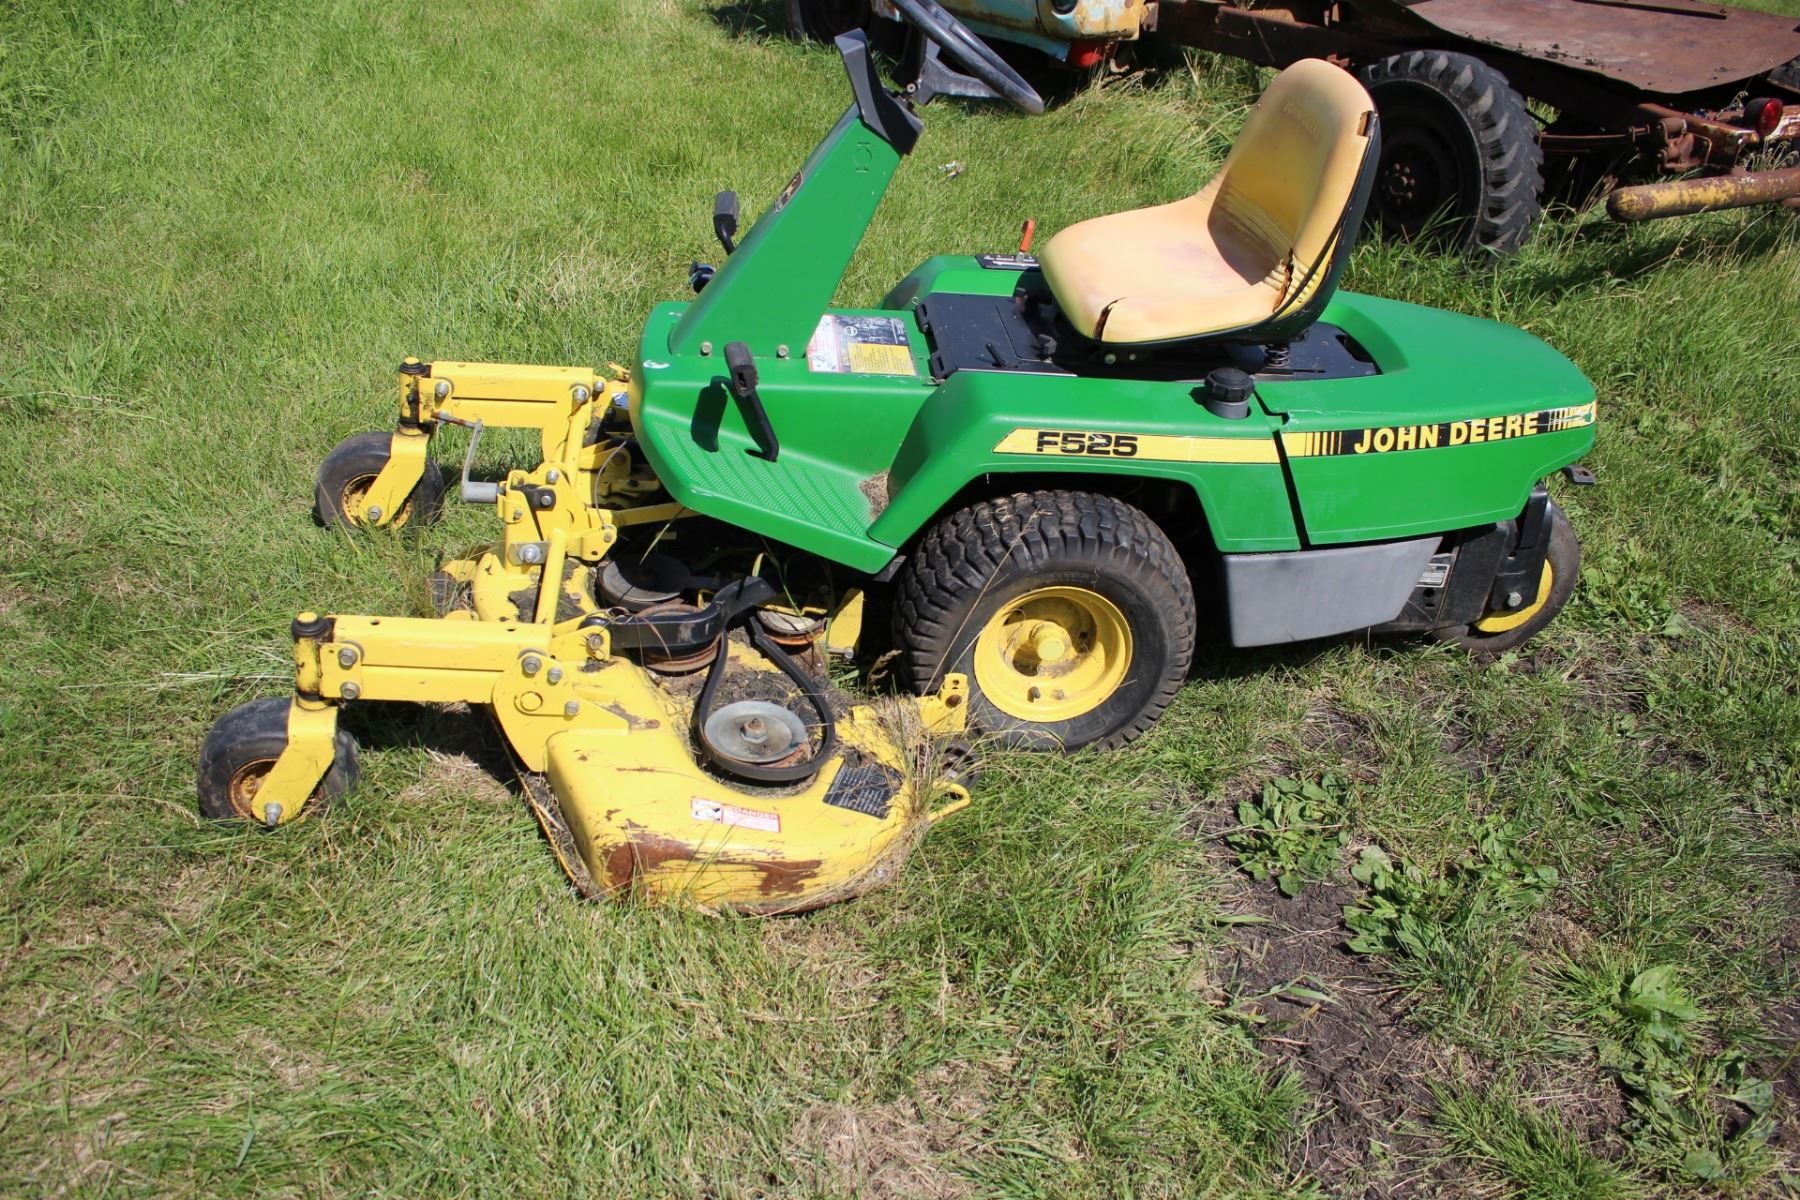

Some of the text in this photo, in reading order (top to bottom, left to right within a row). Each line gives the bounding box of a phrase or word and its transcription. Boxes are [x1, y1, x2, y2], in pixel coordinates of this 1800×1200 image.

[1036, 431, 1138, 457] F525
[1354, 412, 1539, 454] JOHN DEERE
[734, 807, 778, 820] DANGER
